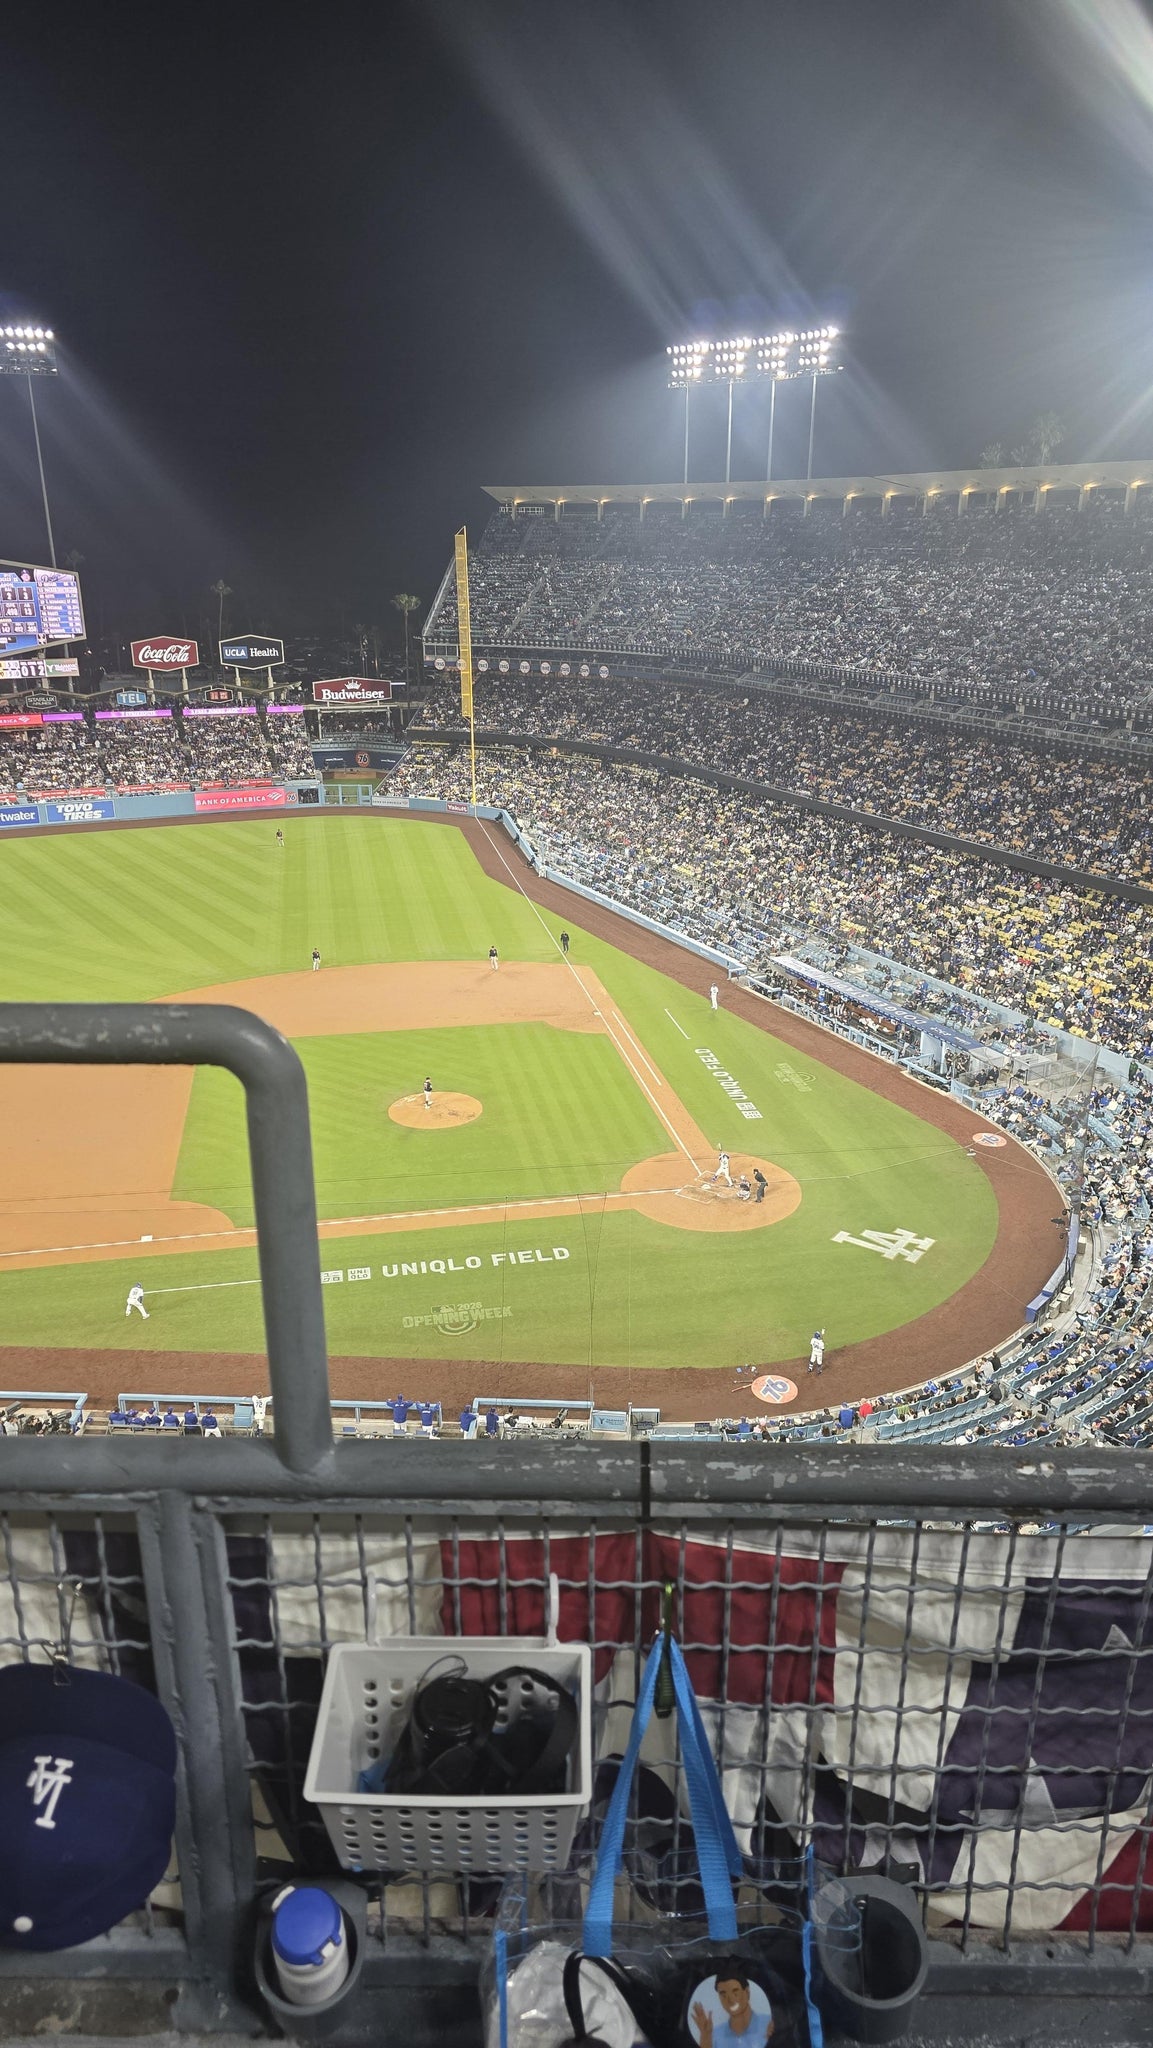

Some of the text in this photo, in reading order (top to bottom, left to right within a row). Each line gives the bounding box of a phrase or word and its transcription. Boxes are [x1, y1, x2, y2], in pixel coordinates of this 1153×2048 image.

[138, 645, 191, 663] Coca-Cola
[225, 648, 279, 658] UCLA Health
[38, 665, 45, 676] 2
[121, 693, 144, 703] TEL
[321, 689, 385, 700] Budweiser
[56, 803, 93, 814] TOYO
[220, 797, 230, 805] OF
[231, 796, 266, 804] AMERICA
[63, 810, 103, 821] TIRES
[694, 1048, 725, 1070] FIELD
[712, 1071, 748, 1101] UNIQLO
[830, 1228, 938, 1265] LA
[382, 1247, 570, 1278] UNIQLO FIELD
[402, 1306, 513, 1328] OPENING WEEK
[760, 1377, 790, 1401] 76
[26, 1755, 74, 1830] LA
